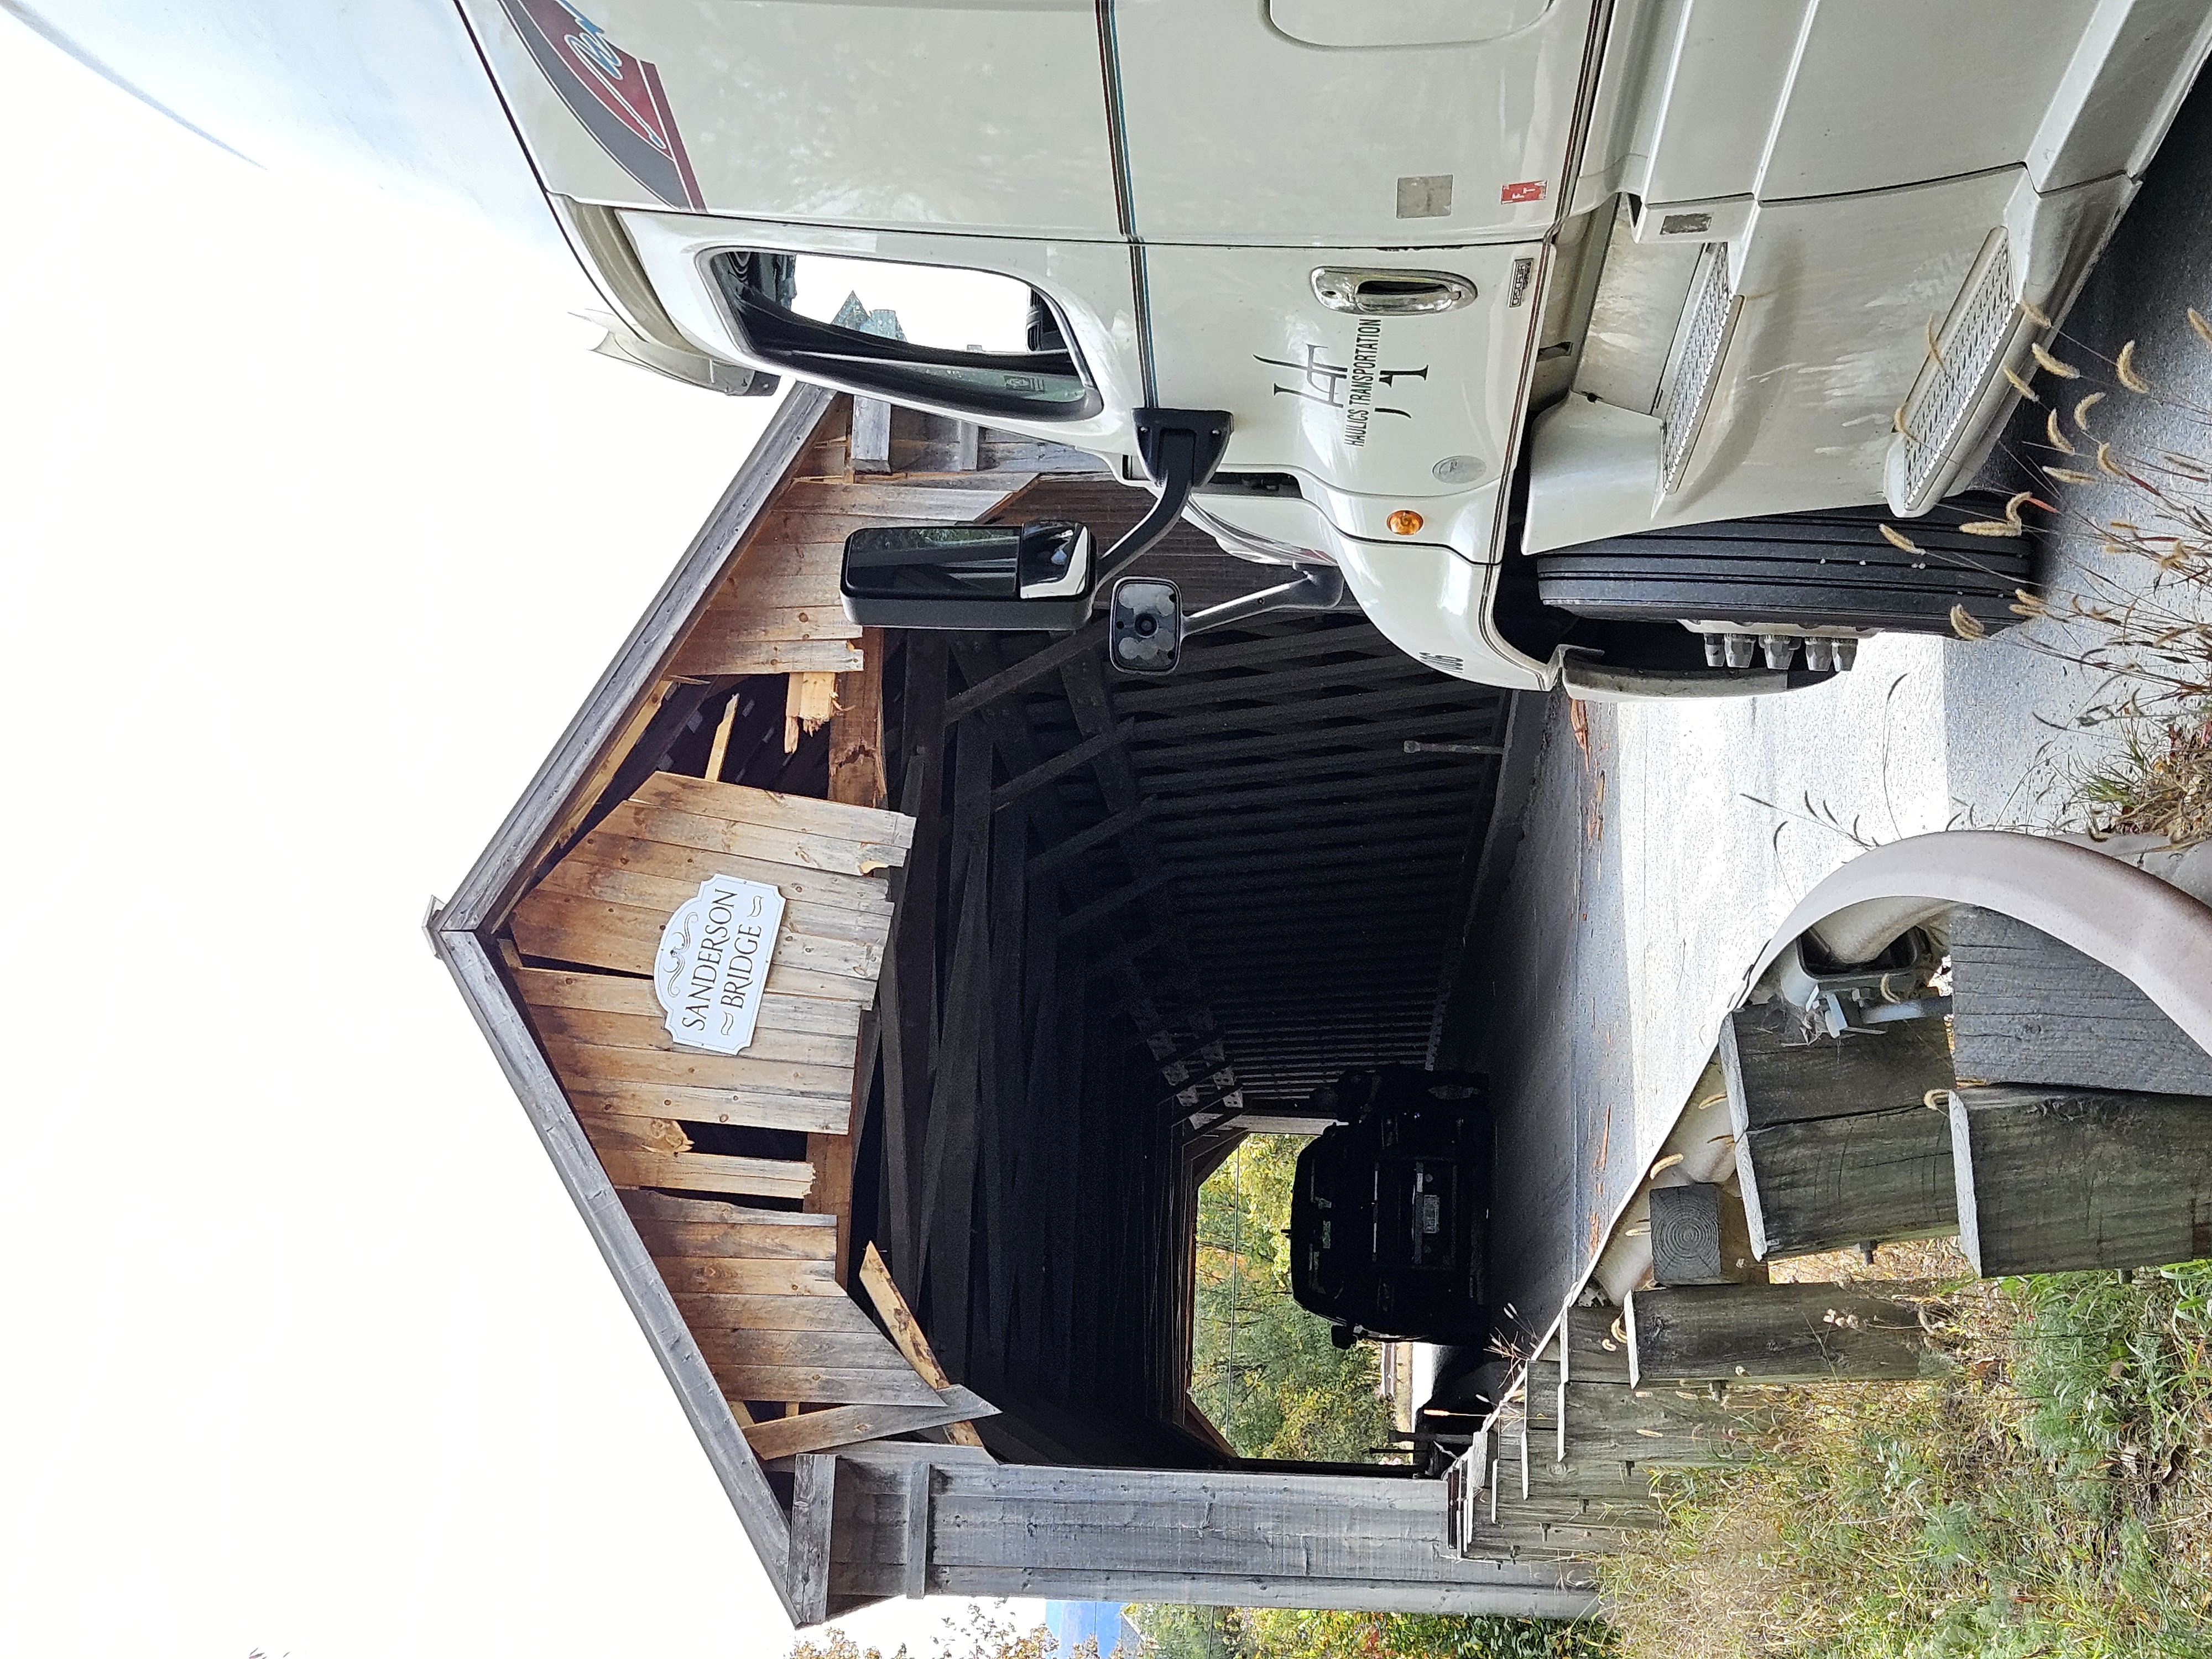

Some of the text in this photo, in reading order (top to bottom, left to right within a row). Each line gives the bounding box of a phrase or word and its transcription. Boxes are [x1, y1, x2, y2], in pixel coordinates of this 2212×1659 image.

[1344, 319, 1381, 447] HAULICS TRANSPORTATION
[682, 888, 738, 1031] SANDERSON
[721, 924, 761, 1009] BRIDGE
